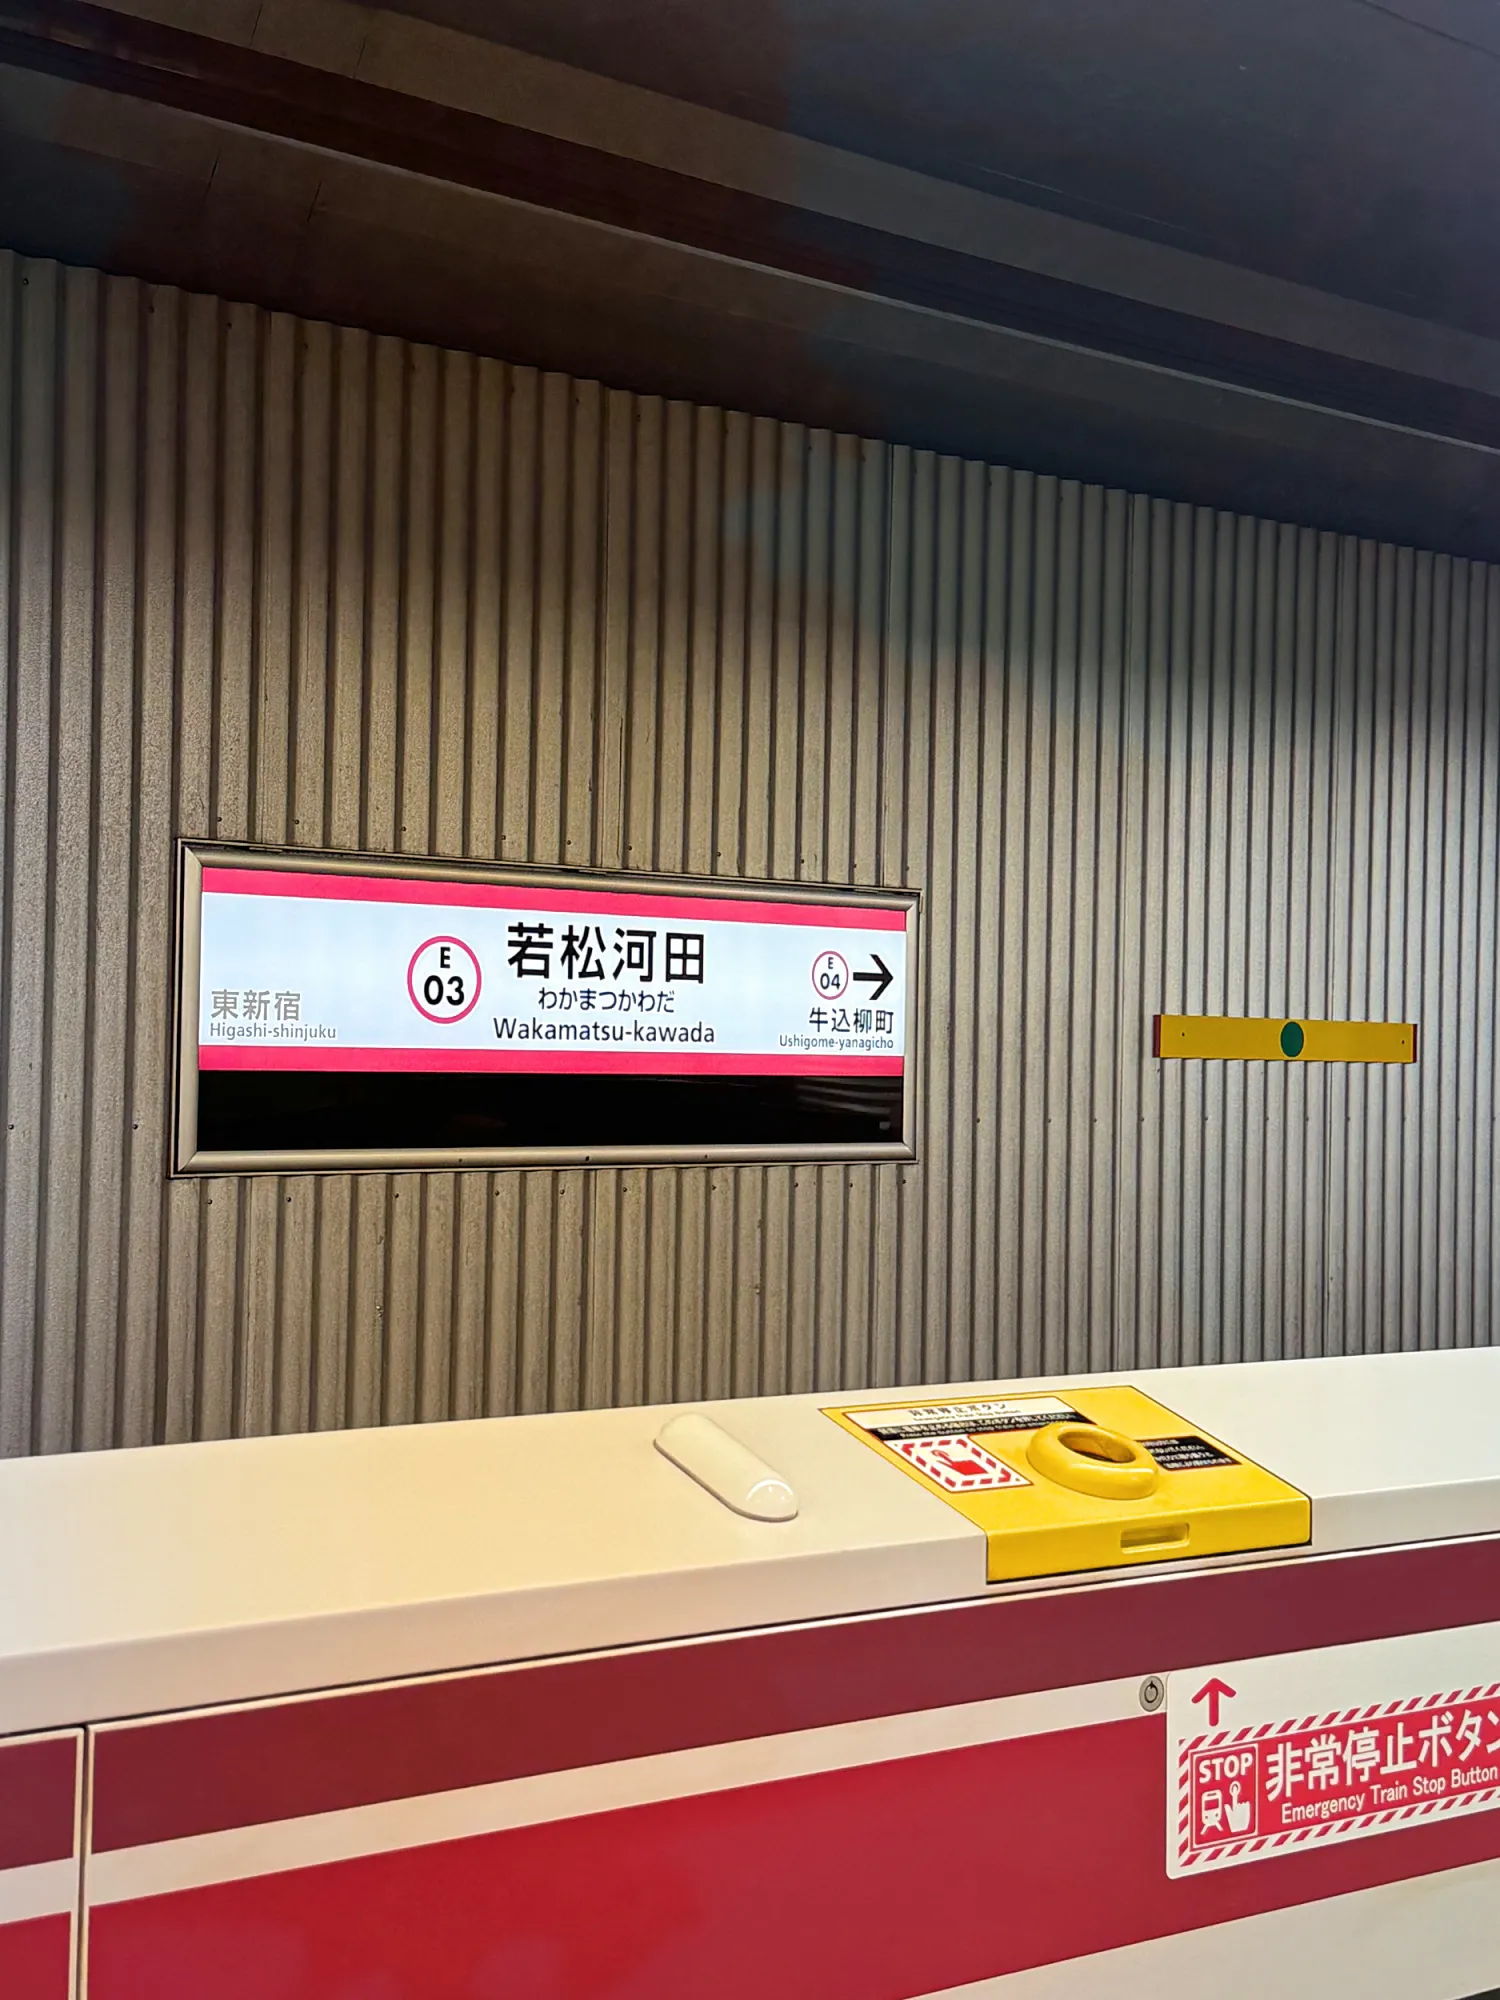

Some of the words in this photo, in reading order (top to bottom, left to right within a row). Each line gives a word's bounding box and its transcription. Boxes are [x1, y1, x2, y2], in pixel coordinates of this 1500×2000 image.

[439, 946, 451, 969] E
[507, 921, 705, 984] 若松河田
[827, 956, 835, 970] E
[423, 974, 465, 1007] 03
[819, 972, 841, 990] 04
[210, 988, 302, 1021] 東新宿
[538, 986, 675, 1013] わかまつかわだ
[209, 1022, 337, 1042] Higashi-shinjuku
[492, 1016, 715, 1043] Wakamatsu-kawada
[808, 1006, 895, 1035] 牛込柳町
[779, 1034, 894, 1052] Ushigome-yanagicho
[1198, 1752, 1254, 1784] STOP
[1281, 1790, 1366, 1825] Emergency
[1369, 1778, 1408, 1806] Train
[1412, 1775, 1446, 1796] Stop
[1450, 1765, 1499, 1789] Button
